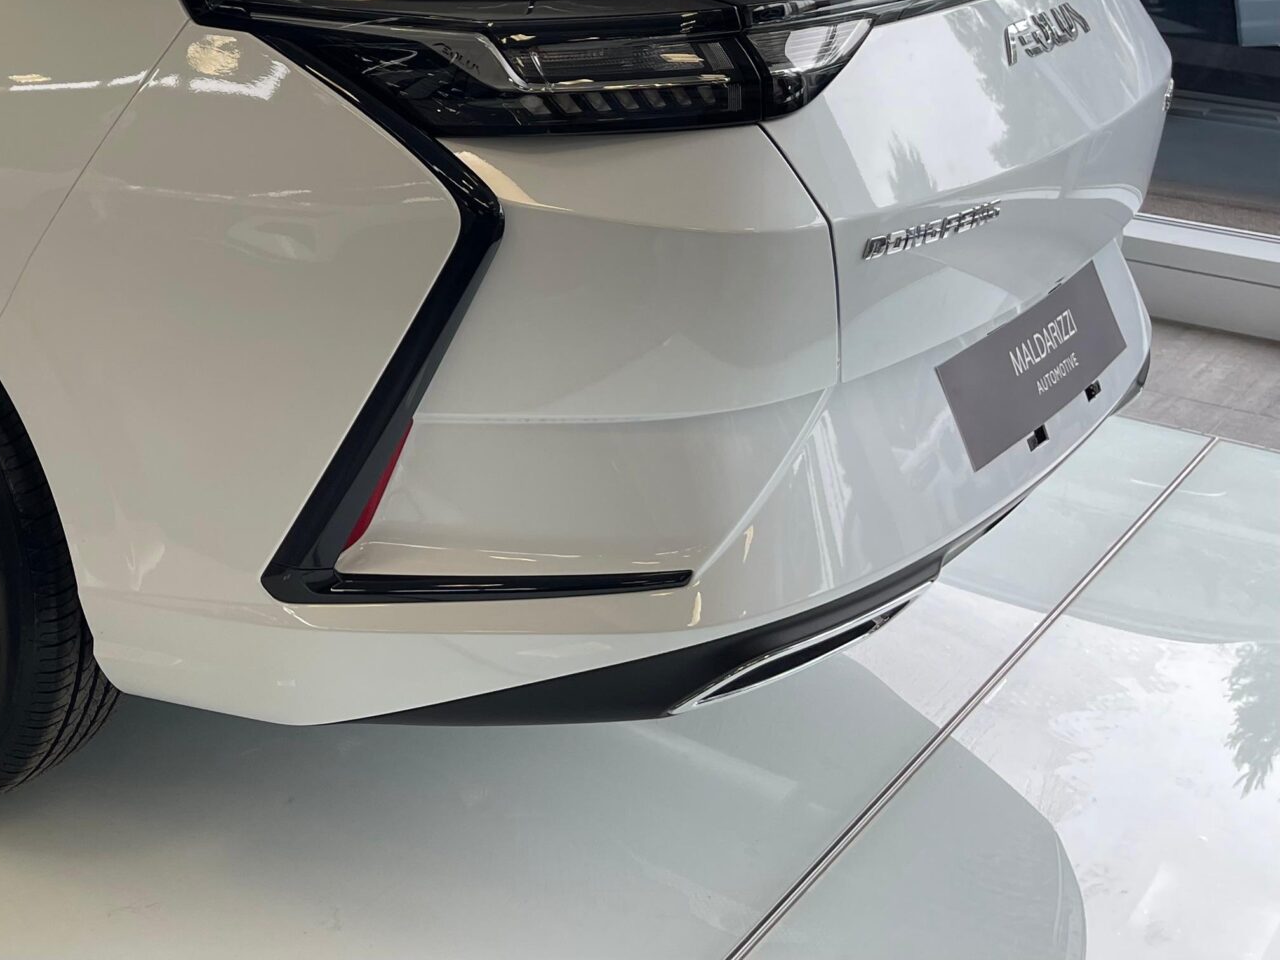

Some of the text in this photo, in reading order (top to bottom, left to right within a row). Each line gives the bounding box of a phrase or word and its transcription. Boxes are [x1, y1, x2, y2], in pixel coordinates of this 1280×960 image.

[862, 198, 1001, 261] DONGFENG
[1008, 308, 1078, 377] MALDARIZZI
[1036, 352, 1080, 395] AUTOMOTIVE
